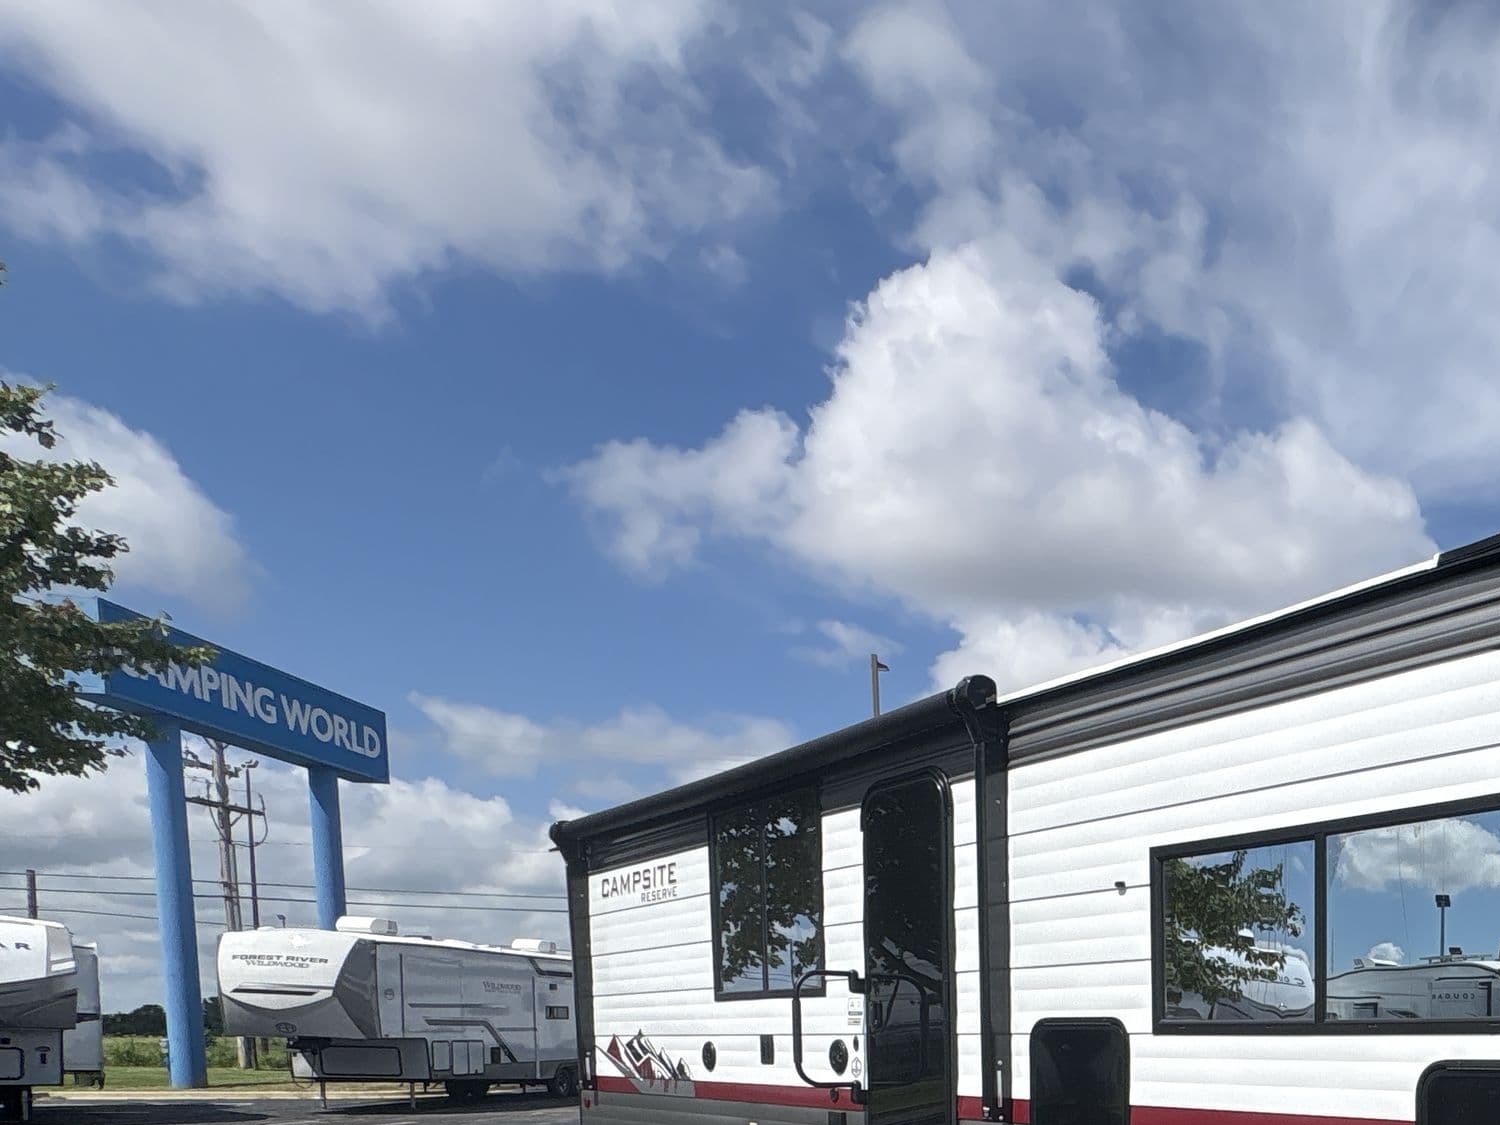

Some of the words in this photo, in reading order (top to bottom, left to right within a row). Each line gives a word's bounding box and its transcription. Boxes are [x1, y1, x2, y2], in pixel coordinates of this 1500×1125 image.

[280, 693, 381, 759] WORLD
[601, 862, 678, 898] CAMPSITE
[640, 886, 678, 903] RESERVE
[244, 959, 310, 969] WILDWOOD
[285, 955, 329, 964] RIVER
